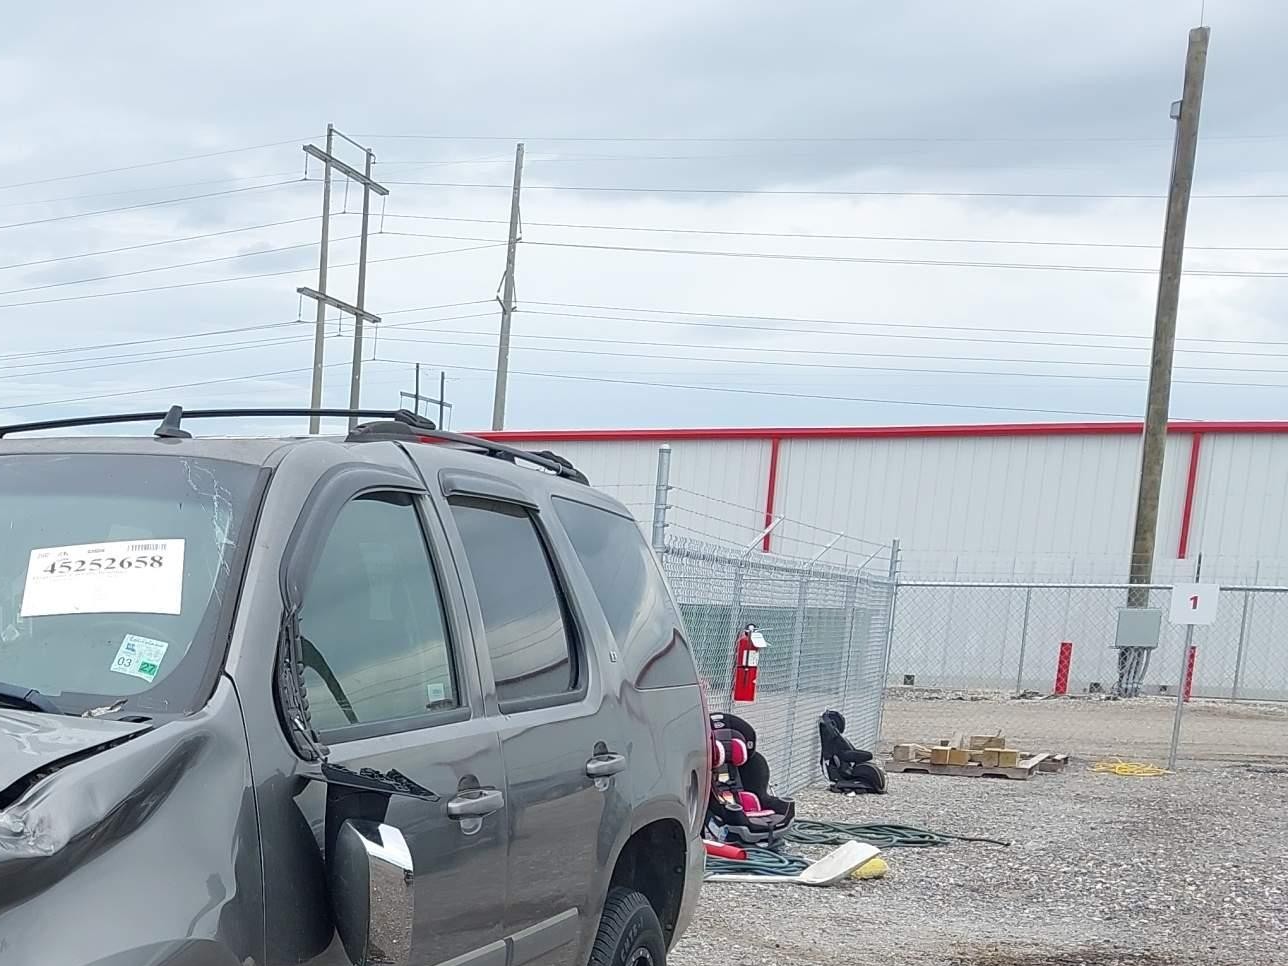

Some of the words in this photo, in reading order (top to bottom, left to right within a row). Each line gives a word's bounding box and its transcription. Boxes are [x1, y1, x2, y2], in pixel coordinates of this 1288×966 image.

[43, 555, 163, 575] 45252658
[1189, 595, 1199, 610] 1
[117, 656, 132, 667] 03
[140, 661, 157, 674] 27
